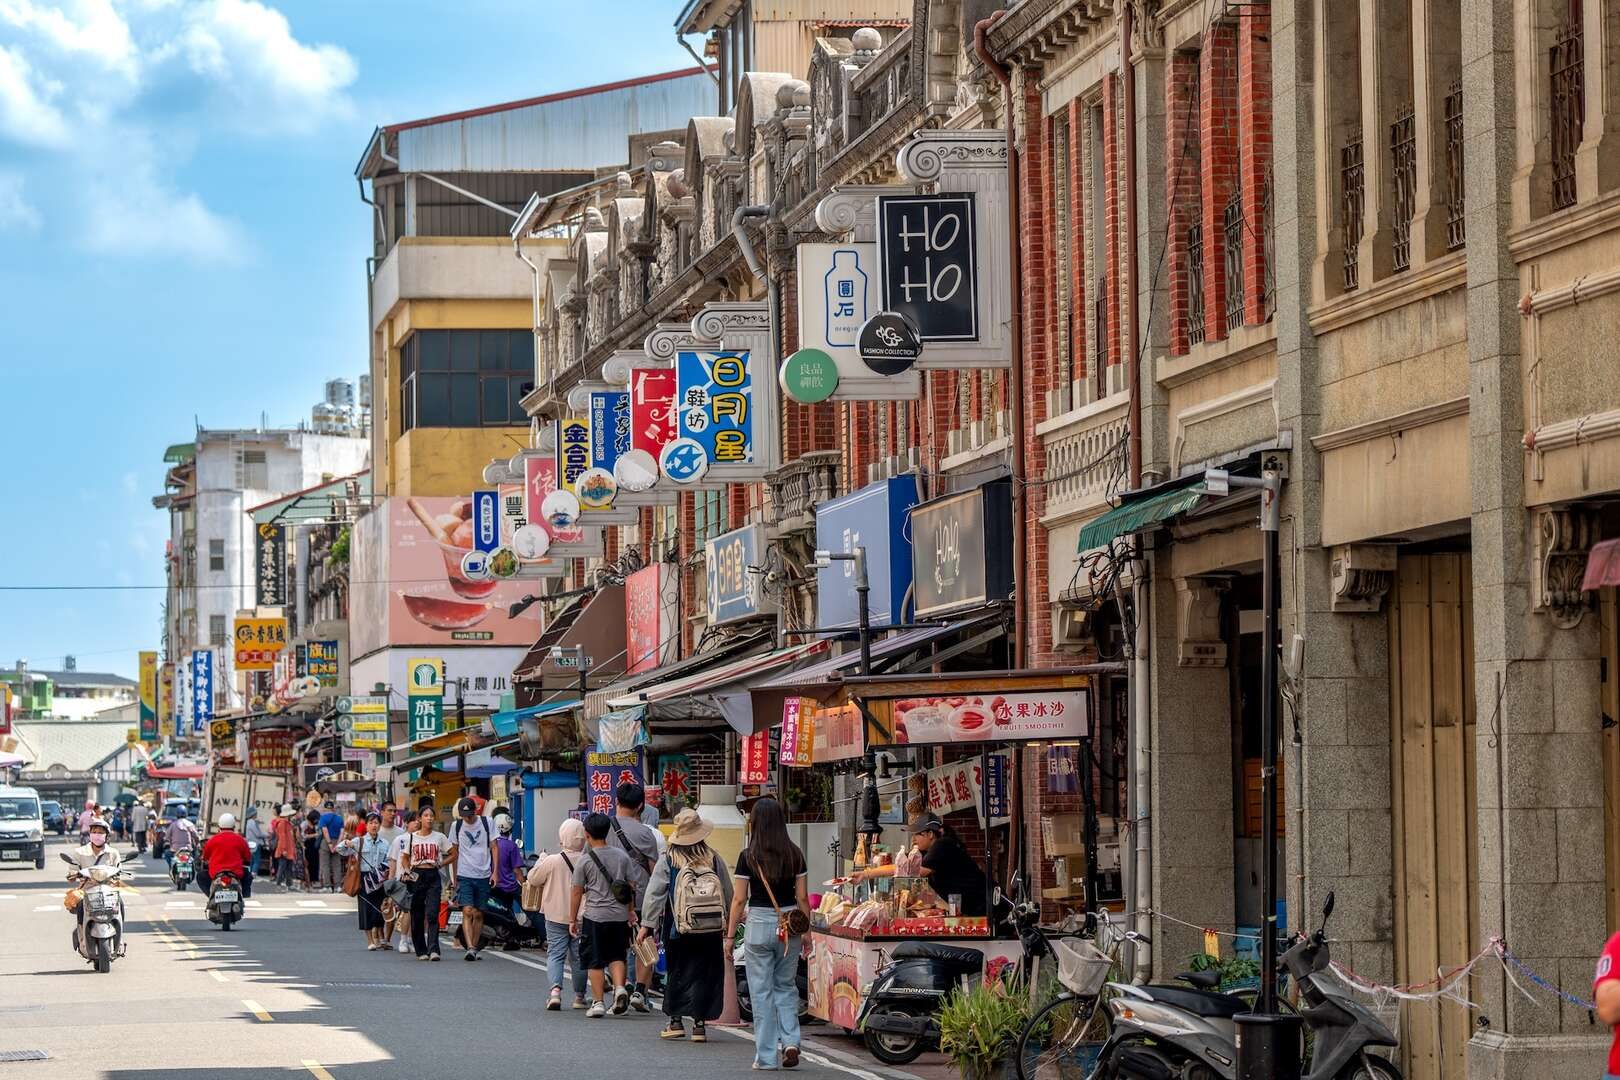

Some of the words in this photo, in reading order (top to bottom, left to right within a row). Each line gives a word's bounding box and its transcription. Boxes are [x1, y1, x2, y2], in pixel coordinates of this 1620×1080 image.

[899, 206, 960, 251] HO
[834, 280, 854, 317] 圓石
[900, 257, 962, 302] HO
[863, 347, 884, 355] FASHION
[884, 348, 915, 356] COLLECTION
[687, 389, 705, 428] 鞋坊
[711, 356, 747, 461] 日月星
[1000, 701, 1065, 719] 水果冰沙
[781, 751, 793, 761] 50
[590, 771, 613, 815] 招牌
[748, 771, 763, 781] 50
